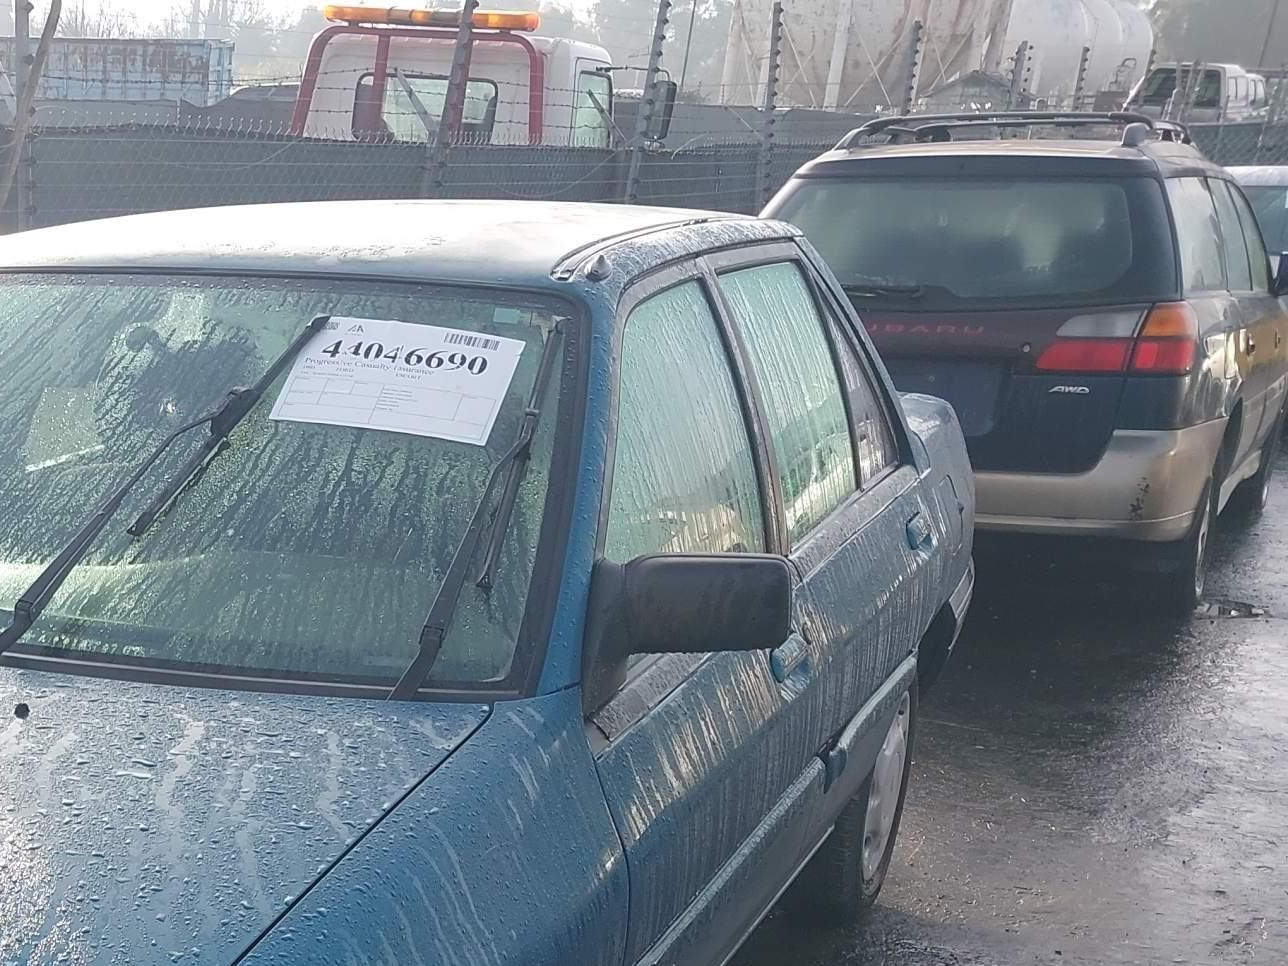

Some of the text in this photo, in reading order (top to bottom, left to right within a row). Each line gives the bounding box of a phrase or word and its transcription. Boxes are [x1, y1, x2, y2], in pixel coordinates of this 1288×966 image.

[320, 339, 488, 376] 44046690
[354, 360, 392, 371] Casualty
[1048, 385, 1090, 394] AWD
